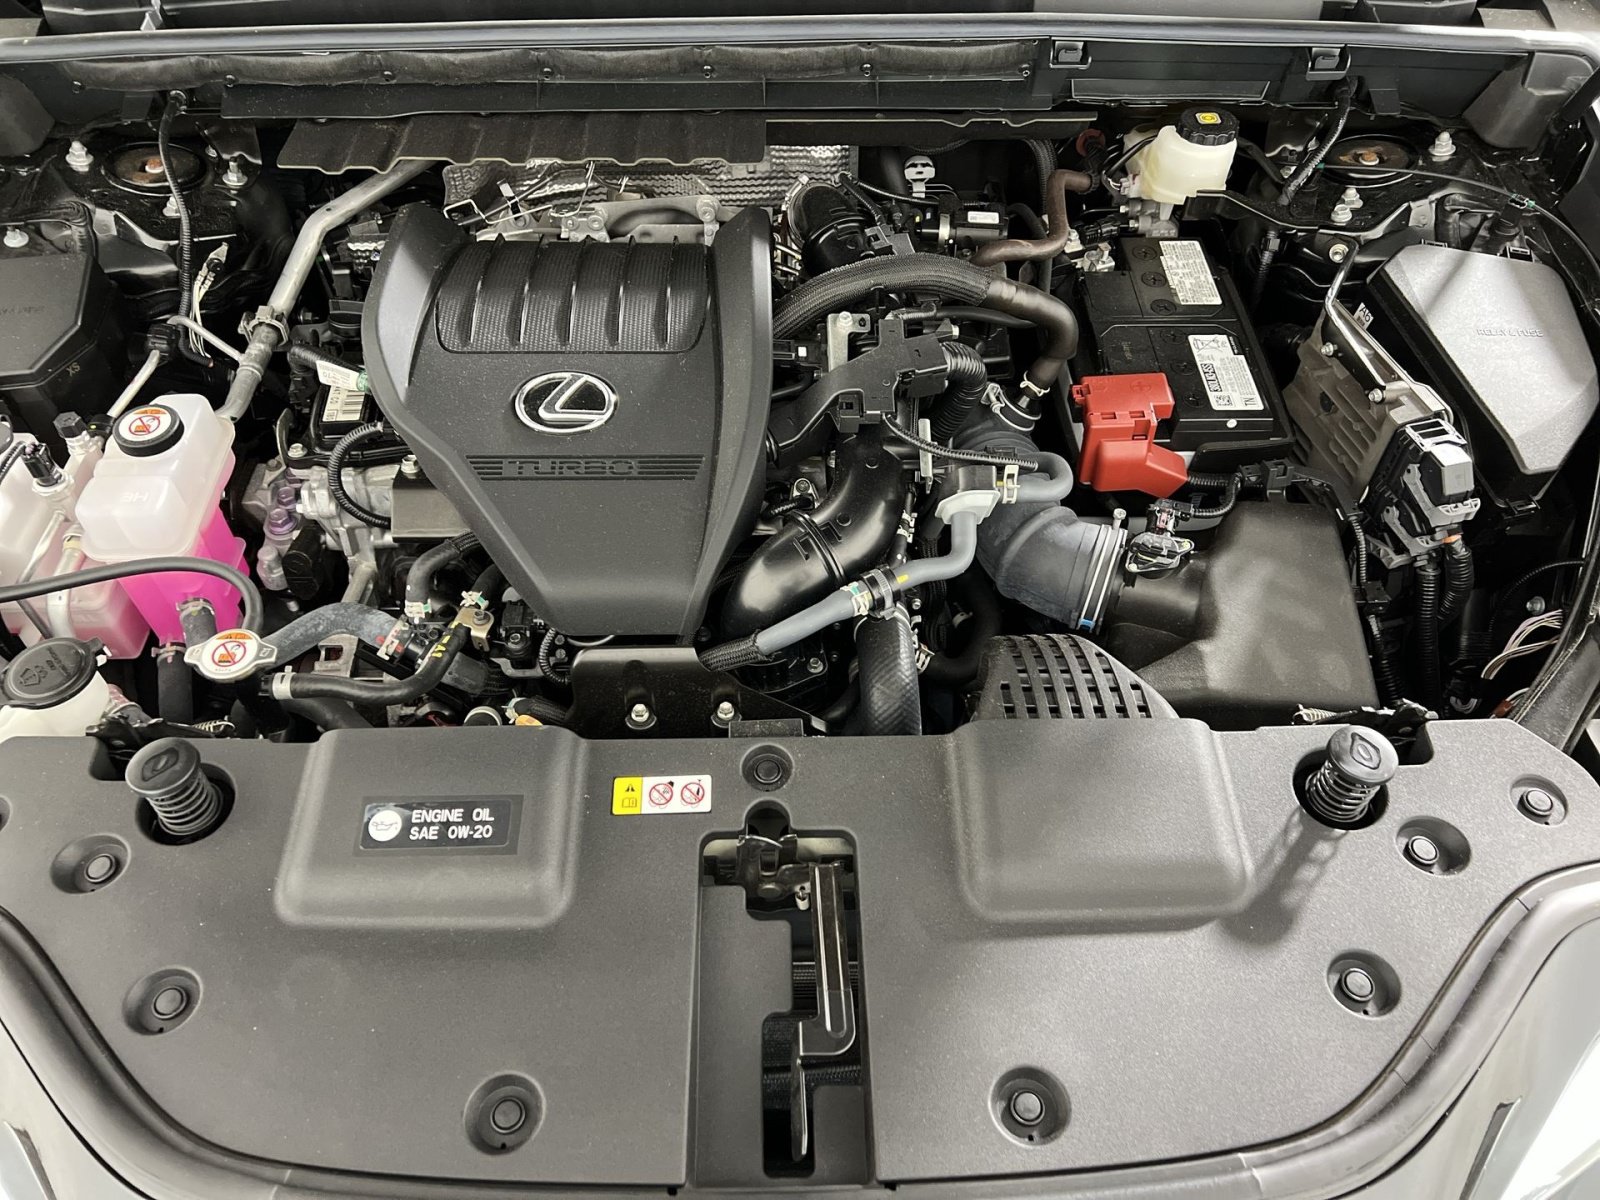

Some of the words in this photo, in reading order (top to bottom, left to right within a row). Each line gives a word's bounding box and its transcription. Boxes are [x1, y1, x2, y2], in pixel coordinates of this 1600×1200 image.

[1476, 328, 1505, 337] RELAY
[1518, 329, 1544, 338] FUSE
[507, 459, 635, 477] TURBO
[412, 808, 464, 823] ENGINE
[472, 807, 495, 822] OIL
[408, 825, 440, 841] SAE
[447, 824, 493, 840] 0W-20
